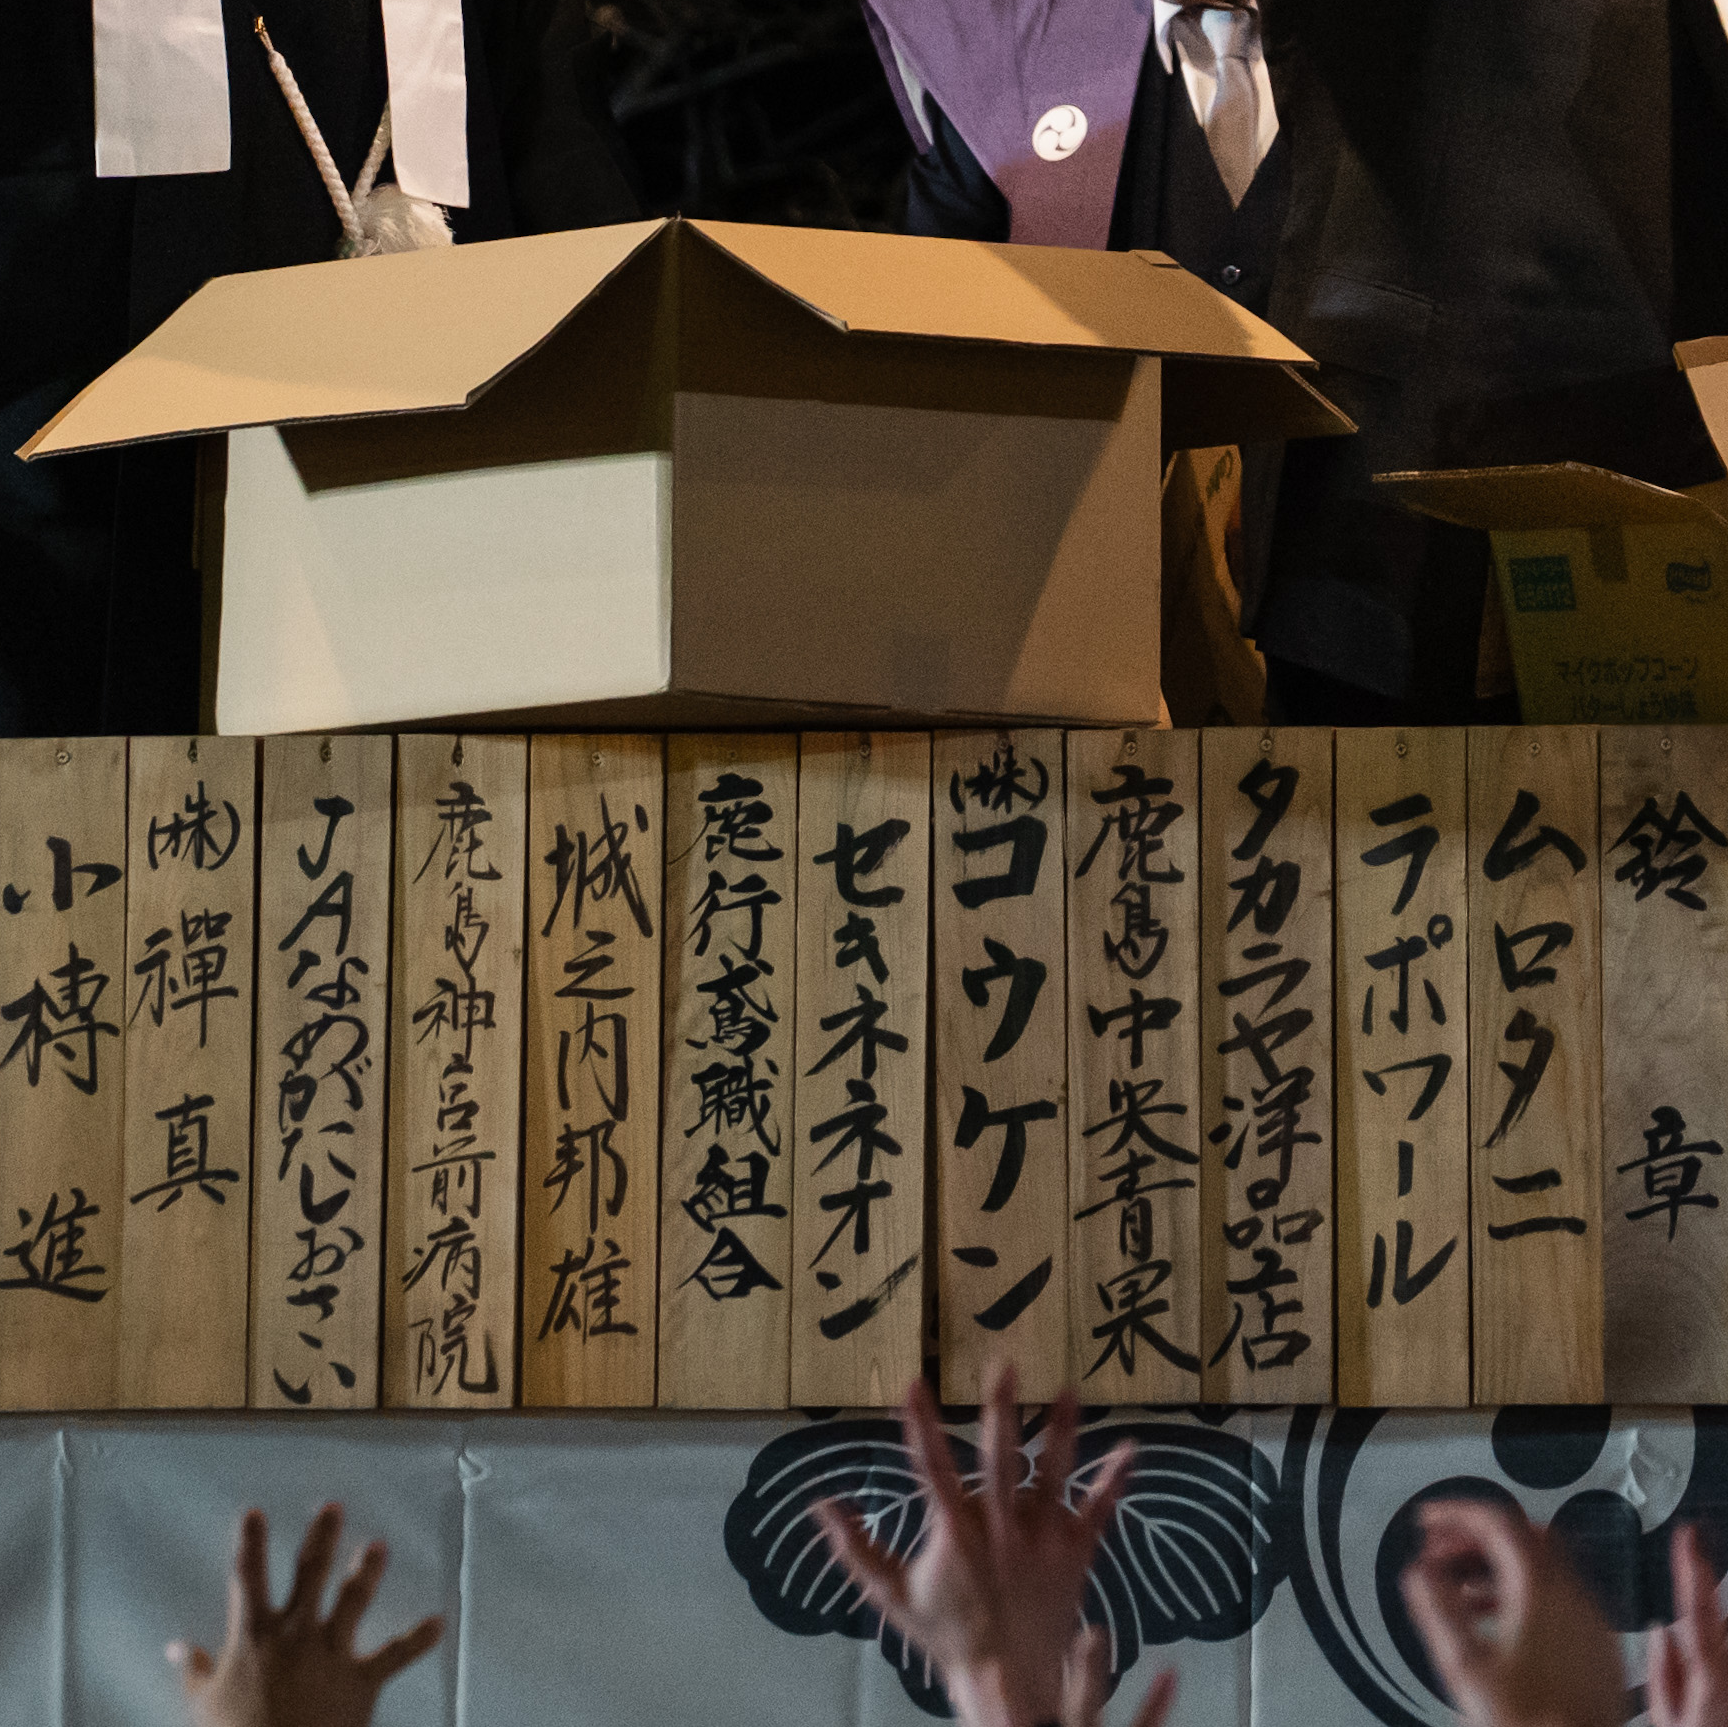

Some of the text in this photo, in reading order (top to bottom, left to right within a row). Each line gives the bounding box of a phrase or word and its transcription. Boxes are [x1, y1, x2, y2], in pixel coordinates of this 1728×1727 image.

[401, 781, 502, 1396] 鹿島神宮前病院
[537, 791, 653, 1346] 城之内邦雄
[671, 773, 787, 1301] 鹿行鳶職組合
[805, 818, 921, 1340] セキネネオン
[1073, 765, 1202, 1380] 鹿島中央青果
[1208, 758, 1323, 1373] タカラヤ洋品店
[1360, 793, 1458, 1308] ラポワール
[1480, 789, 1588, 1242] ムロタニ
